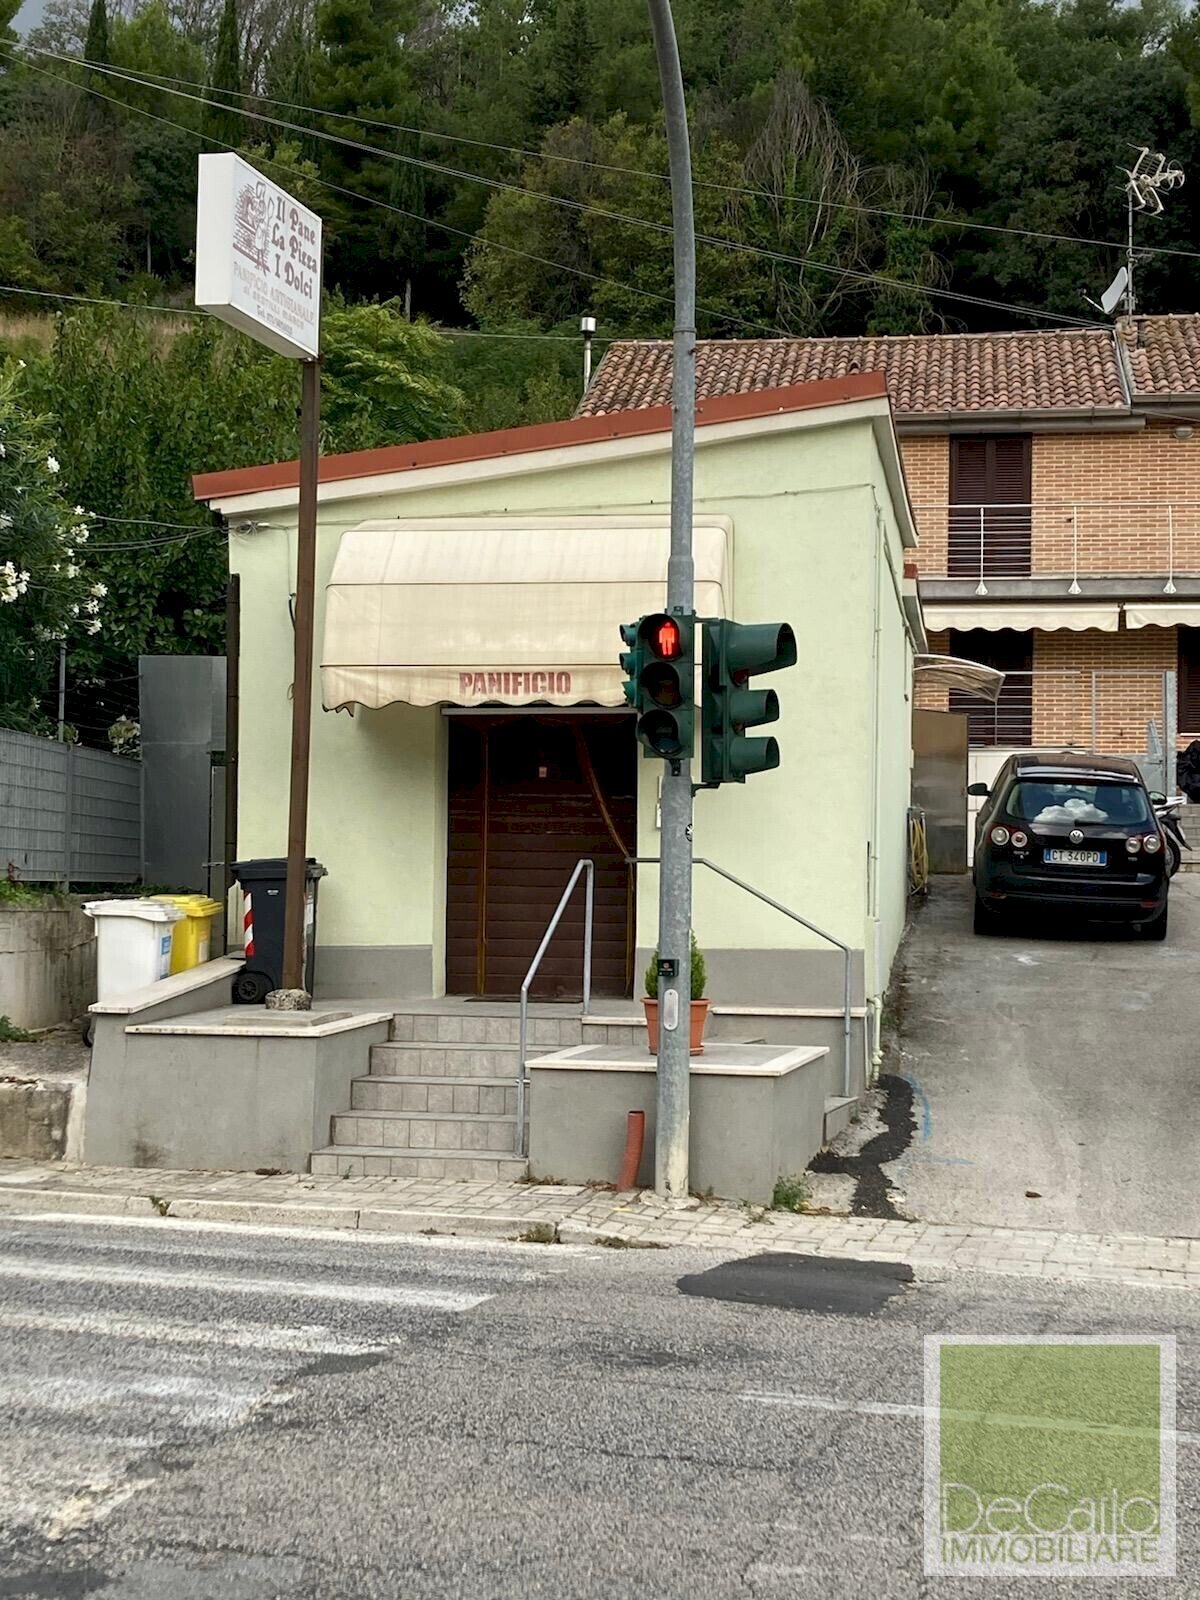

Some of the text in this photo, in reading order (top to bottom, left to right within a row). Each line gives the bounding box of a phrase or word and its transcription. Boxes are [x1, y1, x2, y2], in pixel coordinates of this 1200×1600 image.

[276, 196, 315, 246] Il Pane
[271, 223, 318, 274] La Pizza
[275, 253, 313, 300] I Dolci
[459, 672, 571, 696] PANIFICIO
